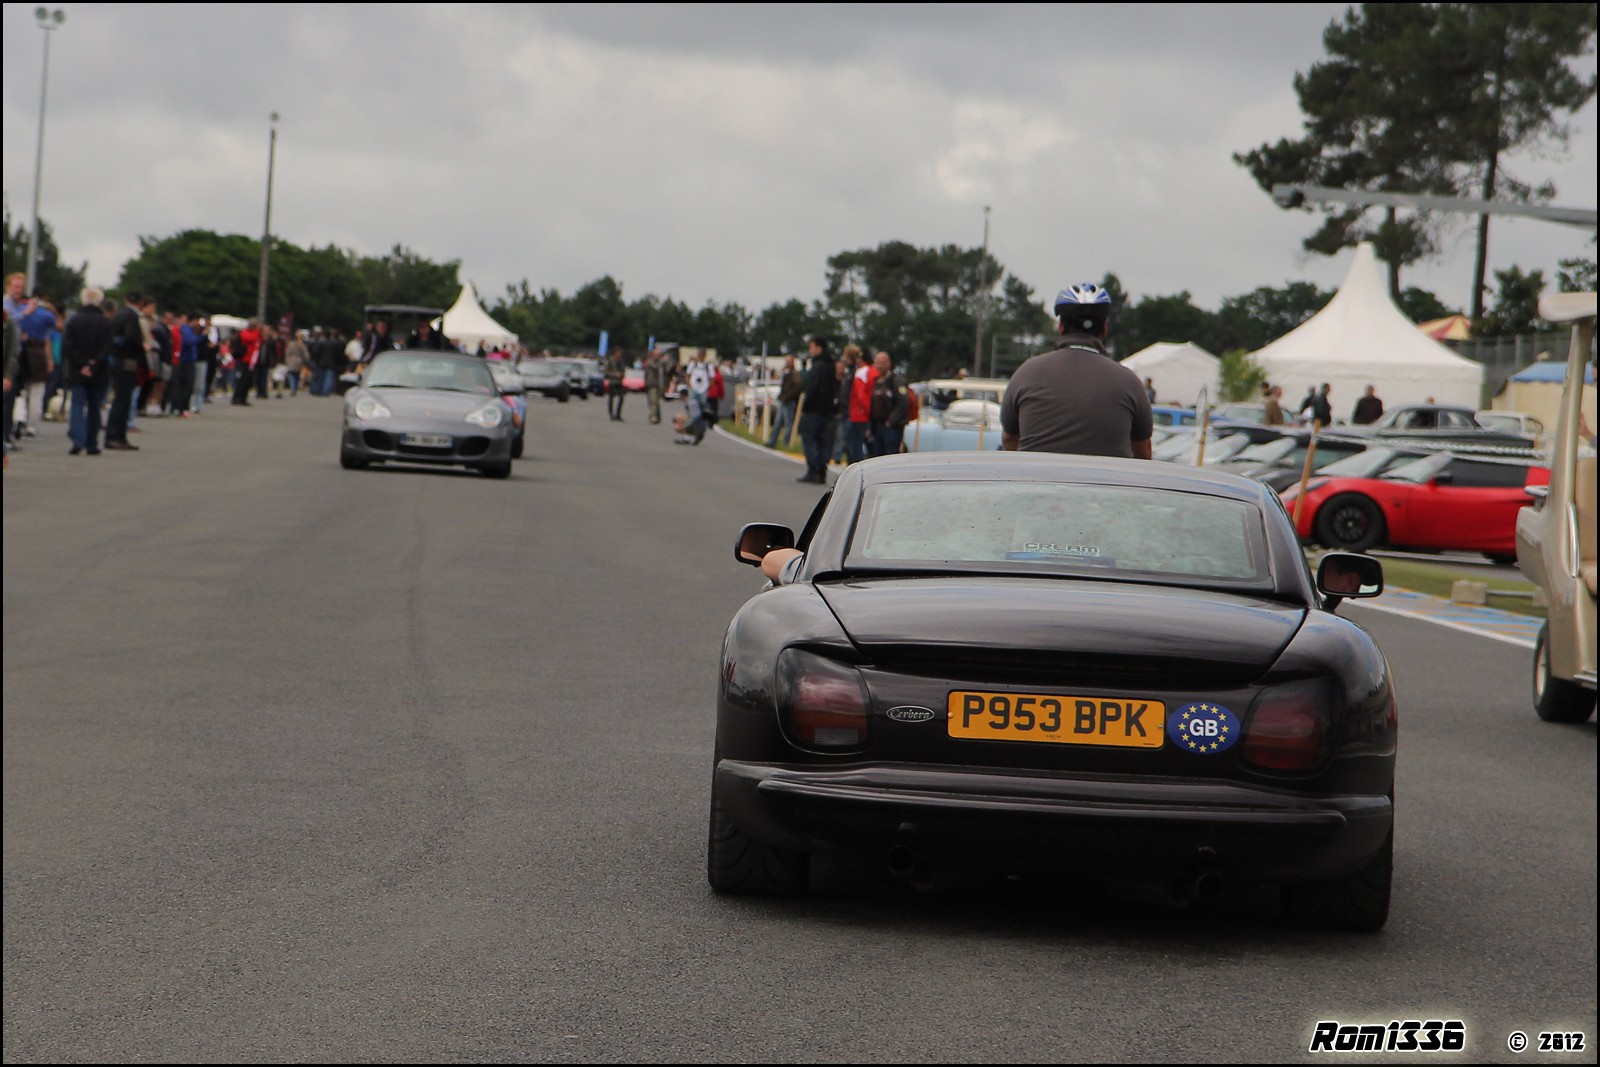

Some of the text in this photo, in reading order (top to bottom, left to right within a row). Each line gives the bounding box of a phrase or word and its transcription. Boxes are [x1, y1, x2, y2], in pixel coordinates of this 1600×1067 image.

[890, 708, 931, 719] Cerbera
[962, 694, 1148, 738] P953 BPK
[1189, 718, 1219, 737] GB
